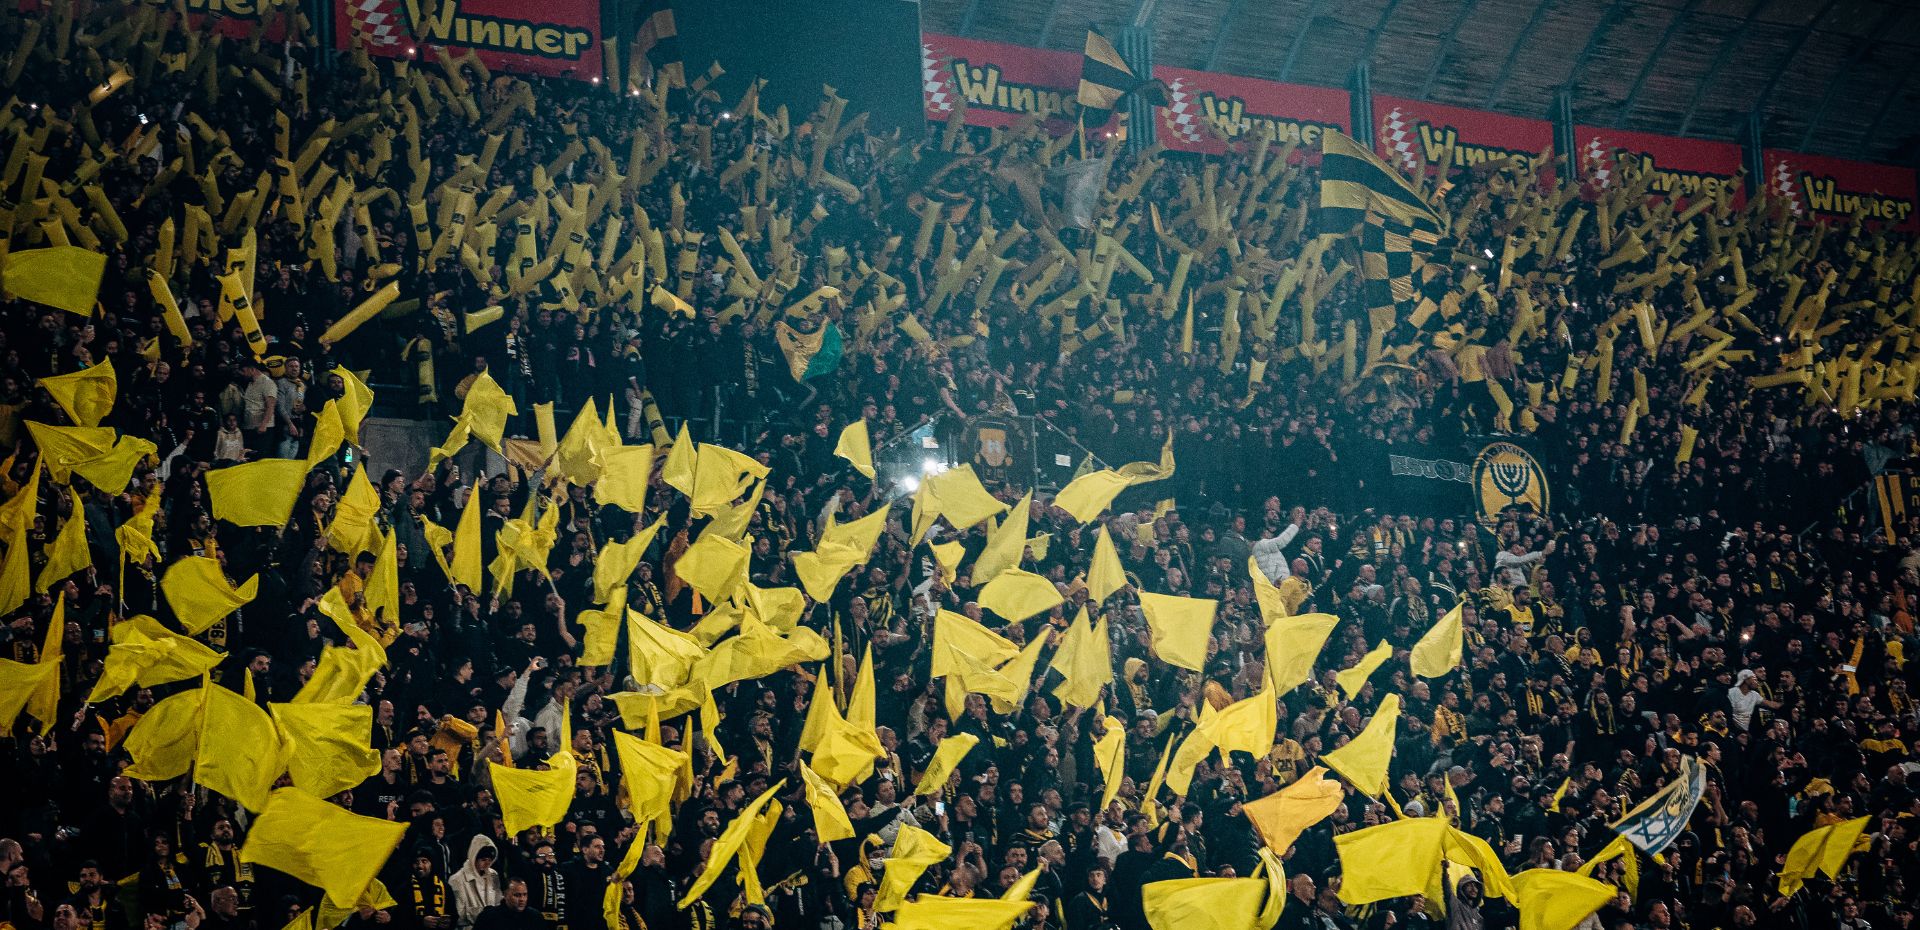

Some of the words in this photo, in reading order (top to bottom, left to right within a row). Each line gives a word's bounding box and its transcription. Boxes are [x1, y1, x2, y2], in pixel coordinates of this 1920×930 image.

[406, 0, 590, 56] Winner
[954, 62, 1079, 117] Winne
[1203, 96, 1323, 146] Winne
